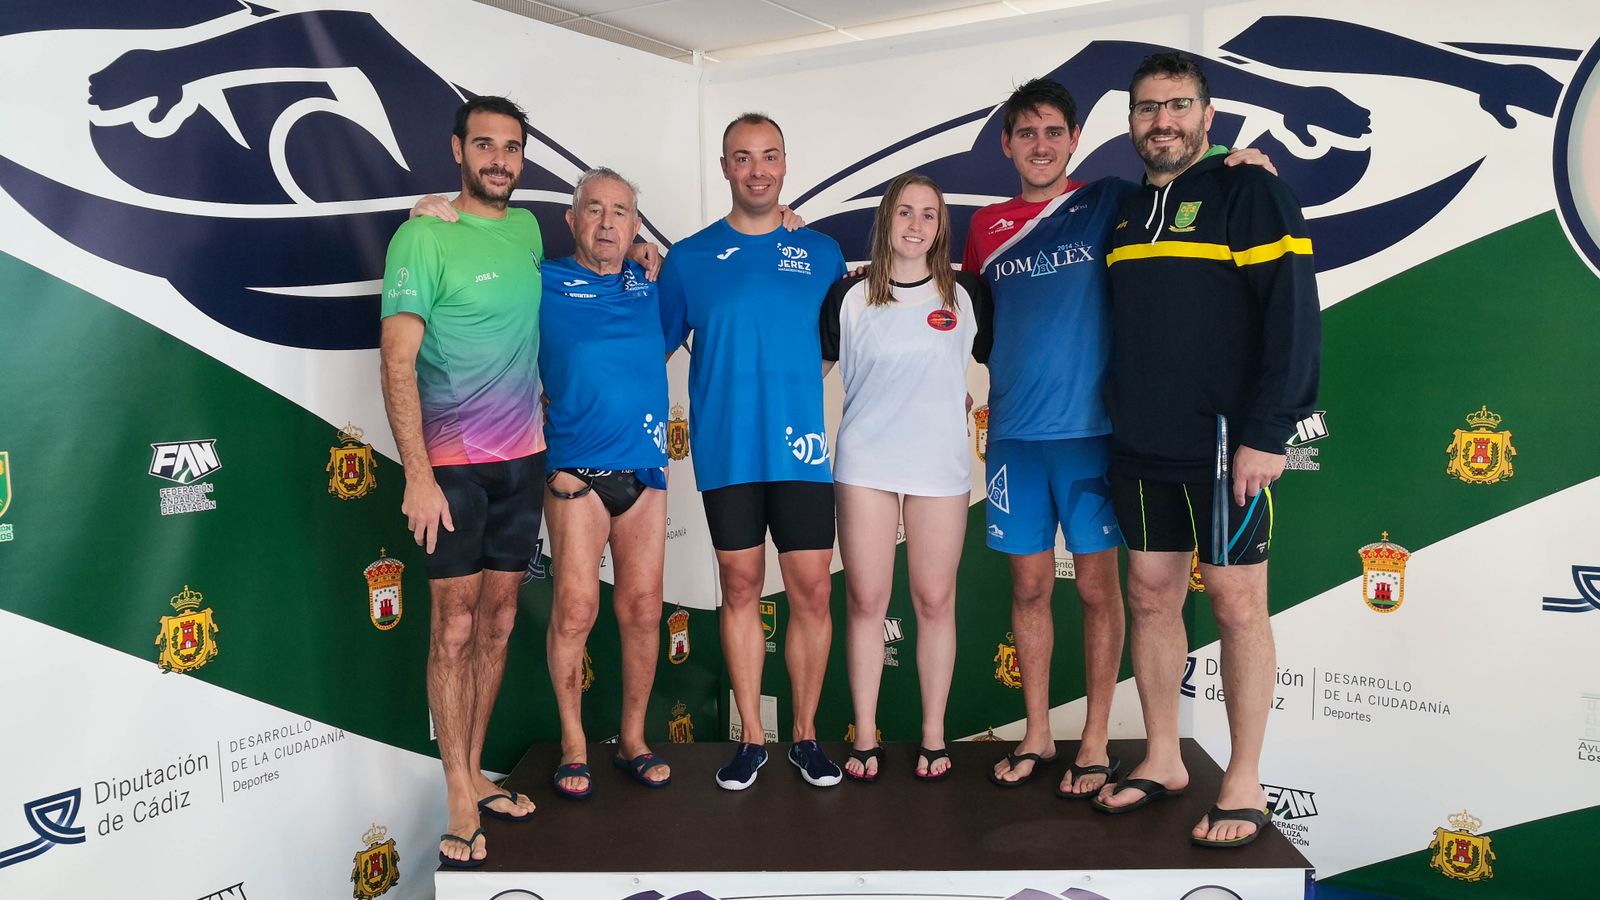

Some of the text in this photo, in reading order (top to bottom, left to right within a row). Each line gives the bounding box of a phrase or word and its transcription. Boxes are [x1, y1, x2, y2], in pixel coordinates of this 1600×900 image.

[1057, 243, 1073, 252] 2014
[778, 259, 811, 271] JEREZ
[475, 273, 491, 283] JOSE
[151, 441, 220, 480] FAN
[1285, 461, 1319, 470] ATACIÓN
[160, 483, 213, 497] FEDERACIÓN
[161, 493, 206, 505] ANDALUZA
[162, 500, 216, 515] DE NATACIÓN
[1325, 672, 1412, 692] DESARROLLO
[1324, 689, 1451, 715] DE LA CIUDADANÍA
[1323, 706, 1372, 722] Deportes
[229, 720, 312, 753] DESARROLLO
[231, 728, 345, 772] DE LA CIUDADANÍA
[94, 753, 208, 805] Diputación
[232, 770, 280, 792] Deportes
[97, 789, 191, 836] de Cádiz
